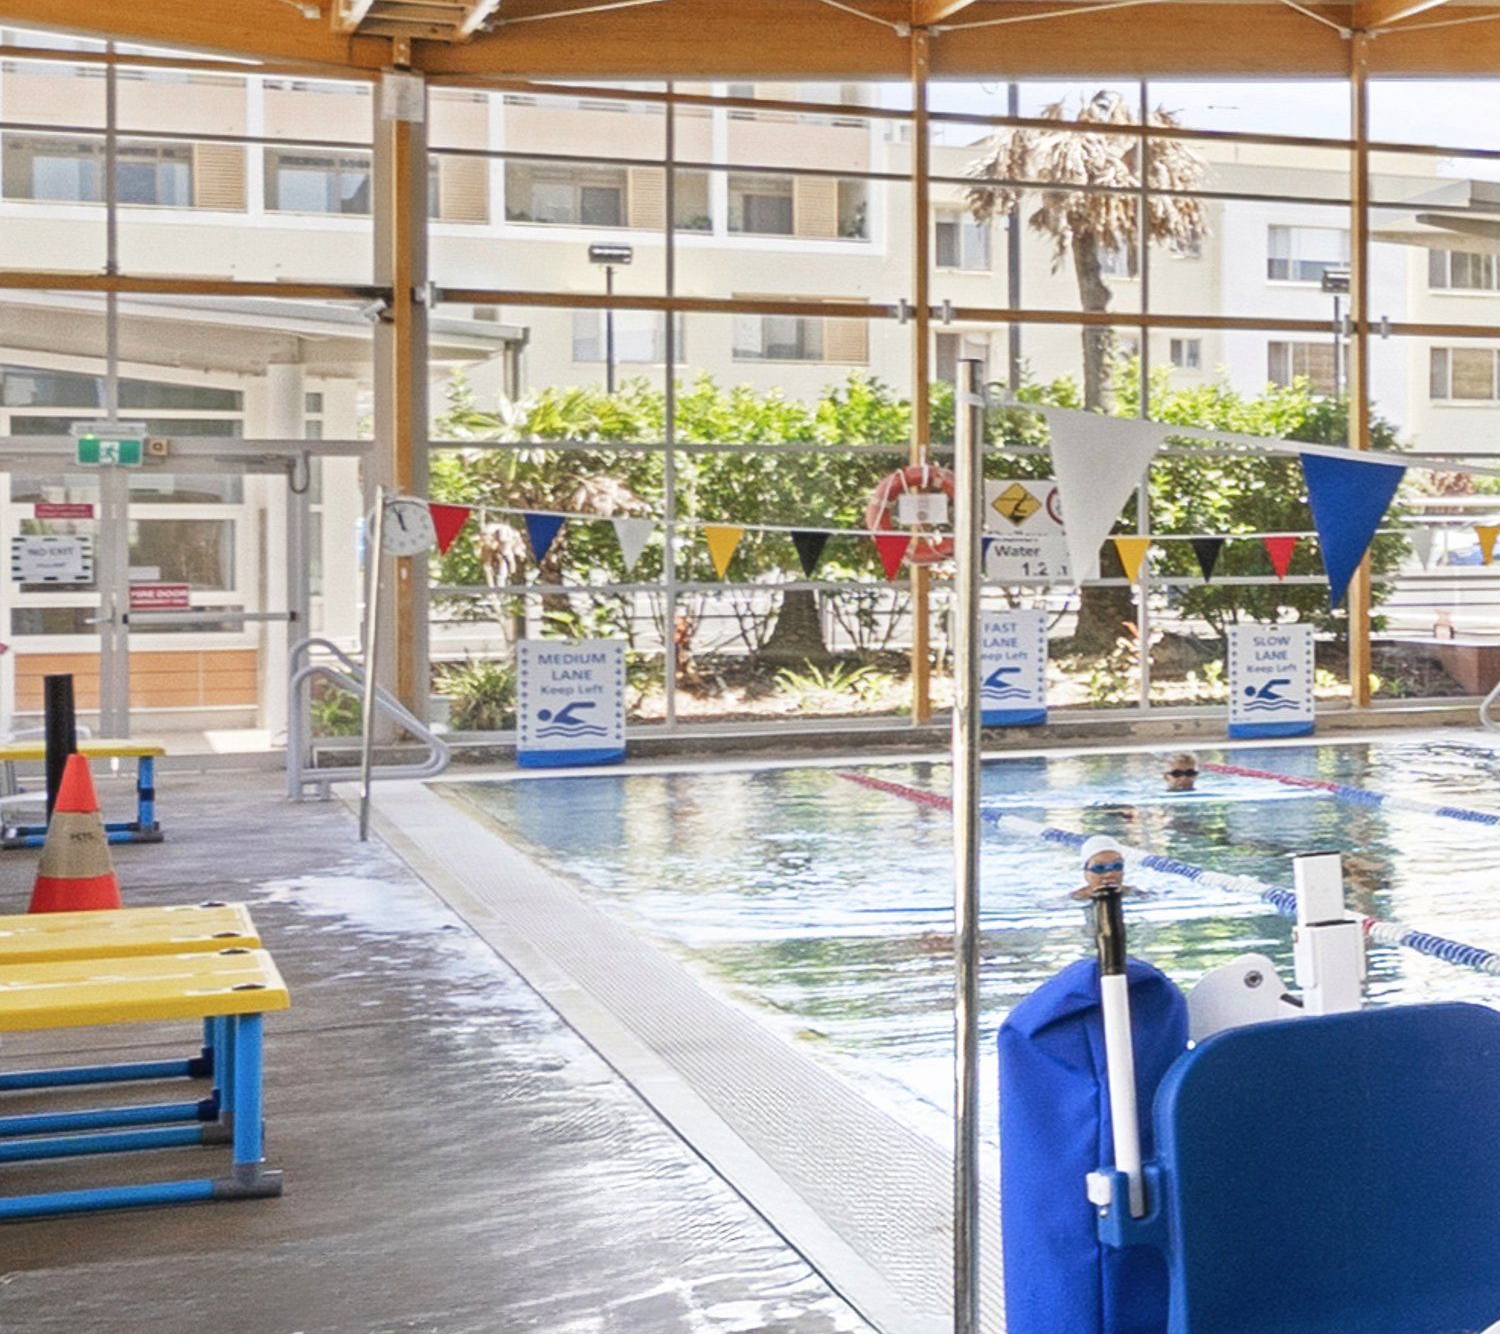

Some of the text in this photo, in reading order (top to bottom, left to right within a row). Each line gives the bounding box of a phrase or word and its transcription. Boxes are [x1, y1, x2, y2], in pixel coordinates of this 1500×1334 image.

[994, 545, 1041, 557] Water
[984, 622, 1017, 633] FAST
[983, 637, 1018, 648] LANE
[1253, 636, 1291, 646] SLOW
[537, 653, 606, 665] MEDIUM
[980, 652, 1003, 661] eep
[1255, 650, 1288, 660] LANE
[552, 669, 593, 681] LANE
[540, 684, 602, 696] Keep Left
